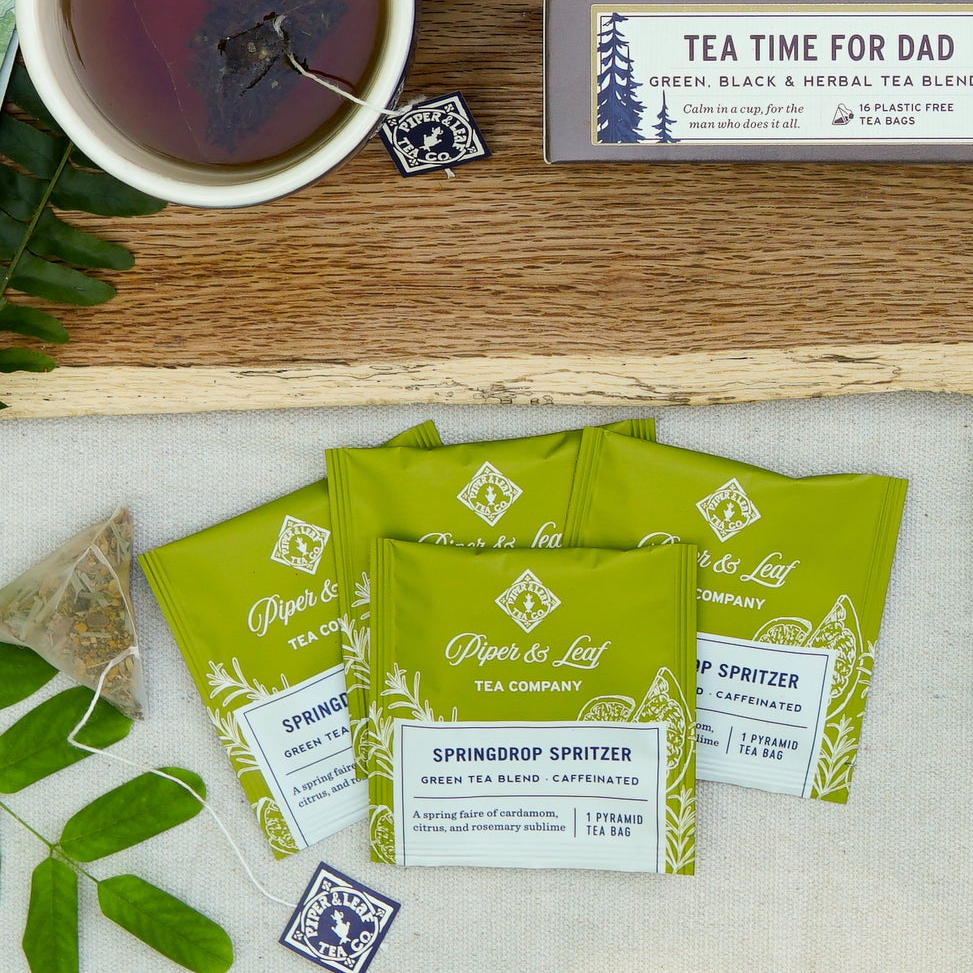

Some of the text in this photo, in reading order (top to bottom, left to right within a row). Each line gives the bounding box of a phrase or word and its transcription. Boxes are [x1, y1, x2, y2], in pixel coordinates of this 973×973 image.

[684, 34, 954, 61] TEA TIME FOR DAD
[650, 76, 712, 89] GREEN,
[720, 76, 775, 87] BLACK
[785, 76, 794, 86] &
[804, 76, 872, 86] HERBAL
[881, 76, 913, 86] TEA
[684, 104, 713, 114] Calm
[765, 104, 783, 115] for
[786, 104, 804, 113] the
[718, 119, 740, 128] who
[743, 119, 768, 128] does
[860, 117, 915, 125] TEA BAGS
[445, 633, 611, 670] Piper & Leaf
[718, 664, 798, 689] SPRITZER
[475, 681, 582, 691] TEA COMPANY
[434, 747, 631, 762] SPRINGDROP SPRITZER
[468, 775, 492, 783] TEA
[553, 775, 638, 785] CAFFEINATED
[423, 812, 457, 820] spring
[487, 809, 498, 817] of
[450, 823, 468, 831] and
[524, 822, 565, 831] sublime
